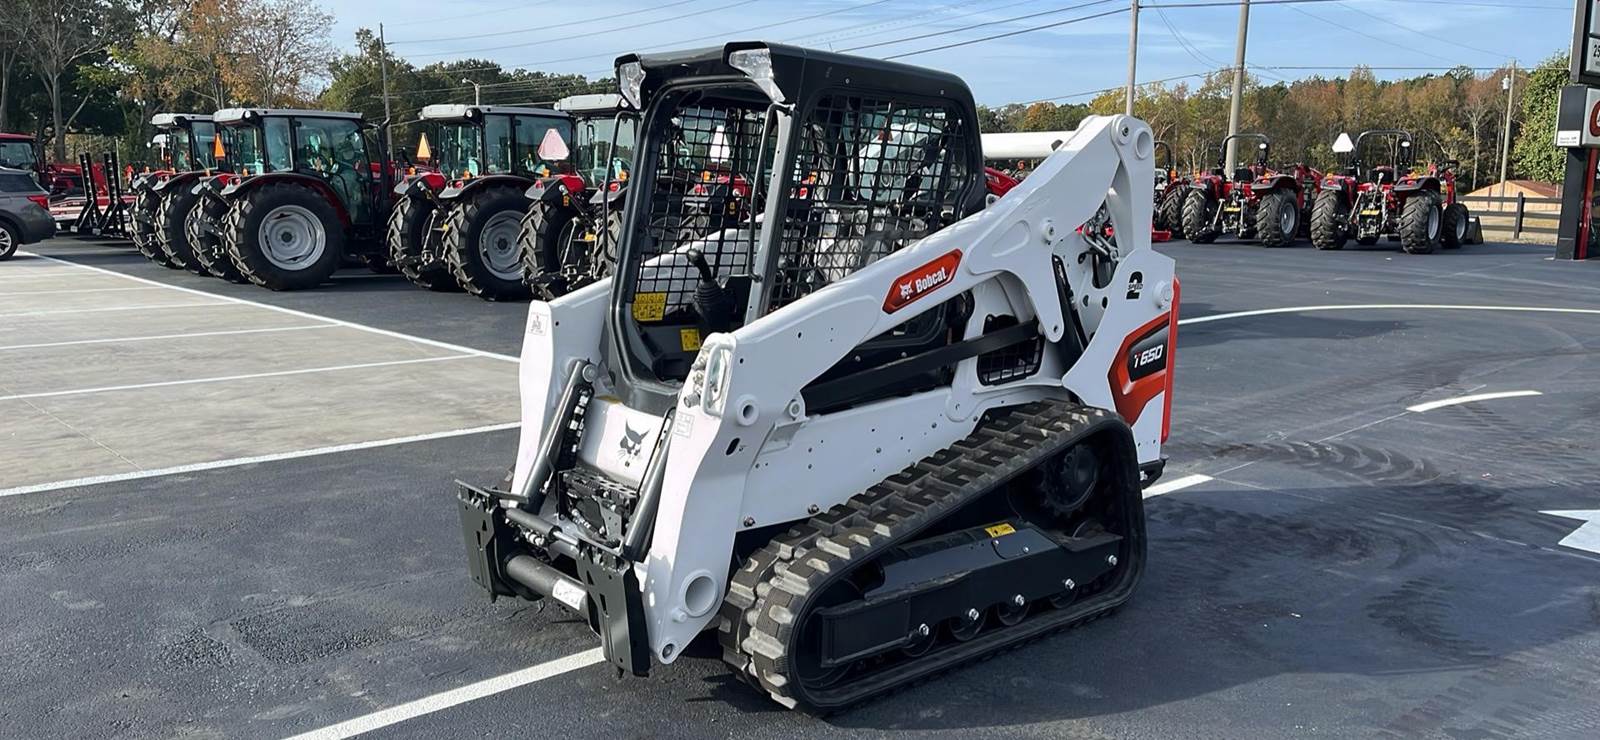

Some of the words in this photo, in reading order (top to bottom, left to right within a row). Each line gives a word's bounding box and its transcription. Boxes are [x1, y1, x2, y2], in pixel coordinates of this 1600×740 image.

[917, 267, 946, 293] Bobcat
[1126, 271, 1143, 299] 2
[1134, 344, 1163, 368] T650
